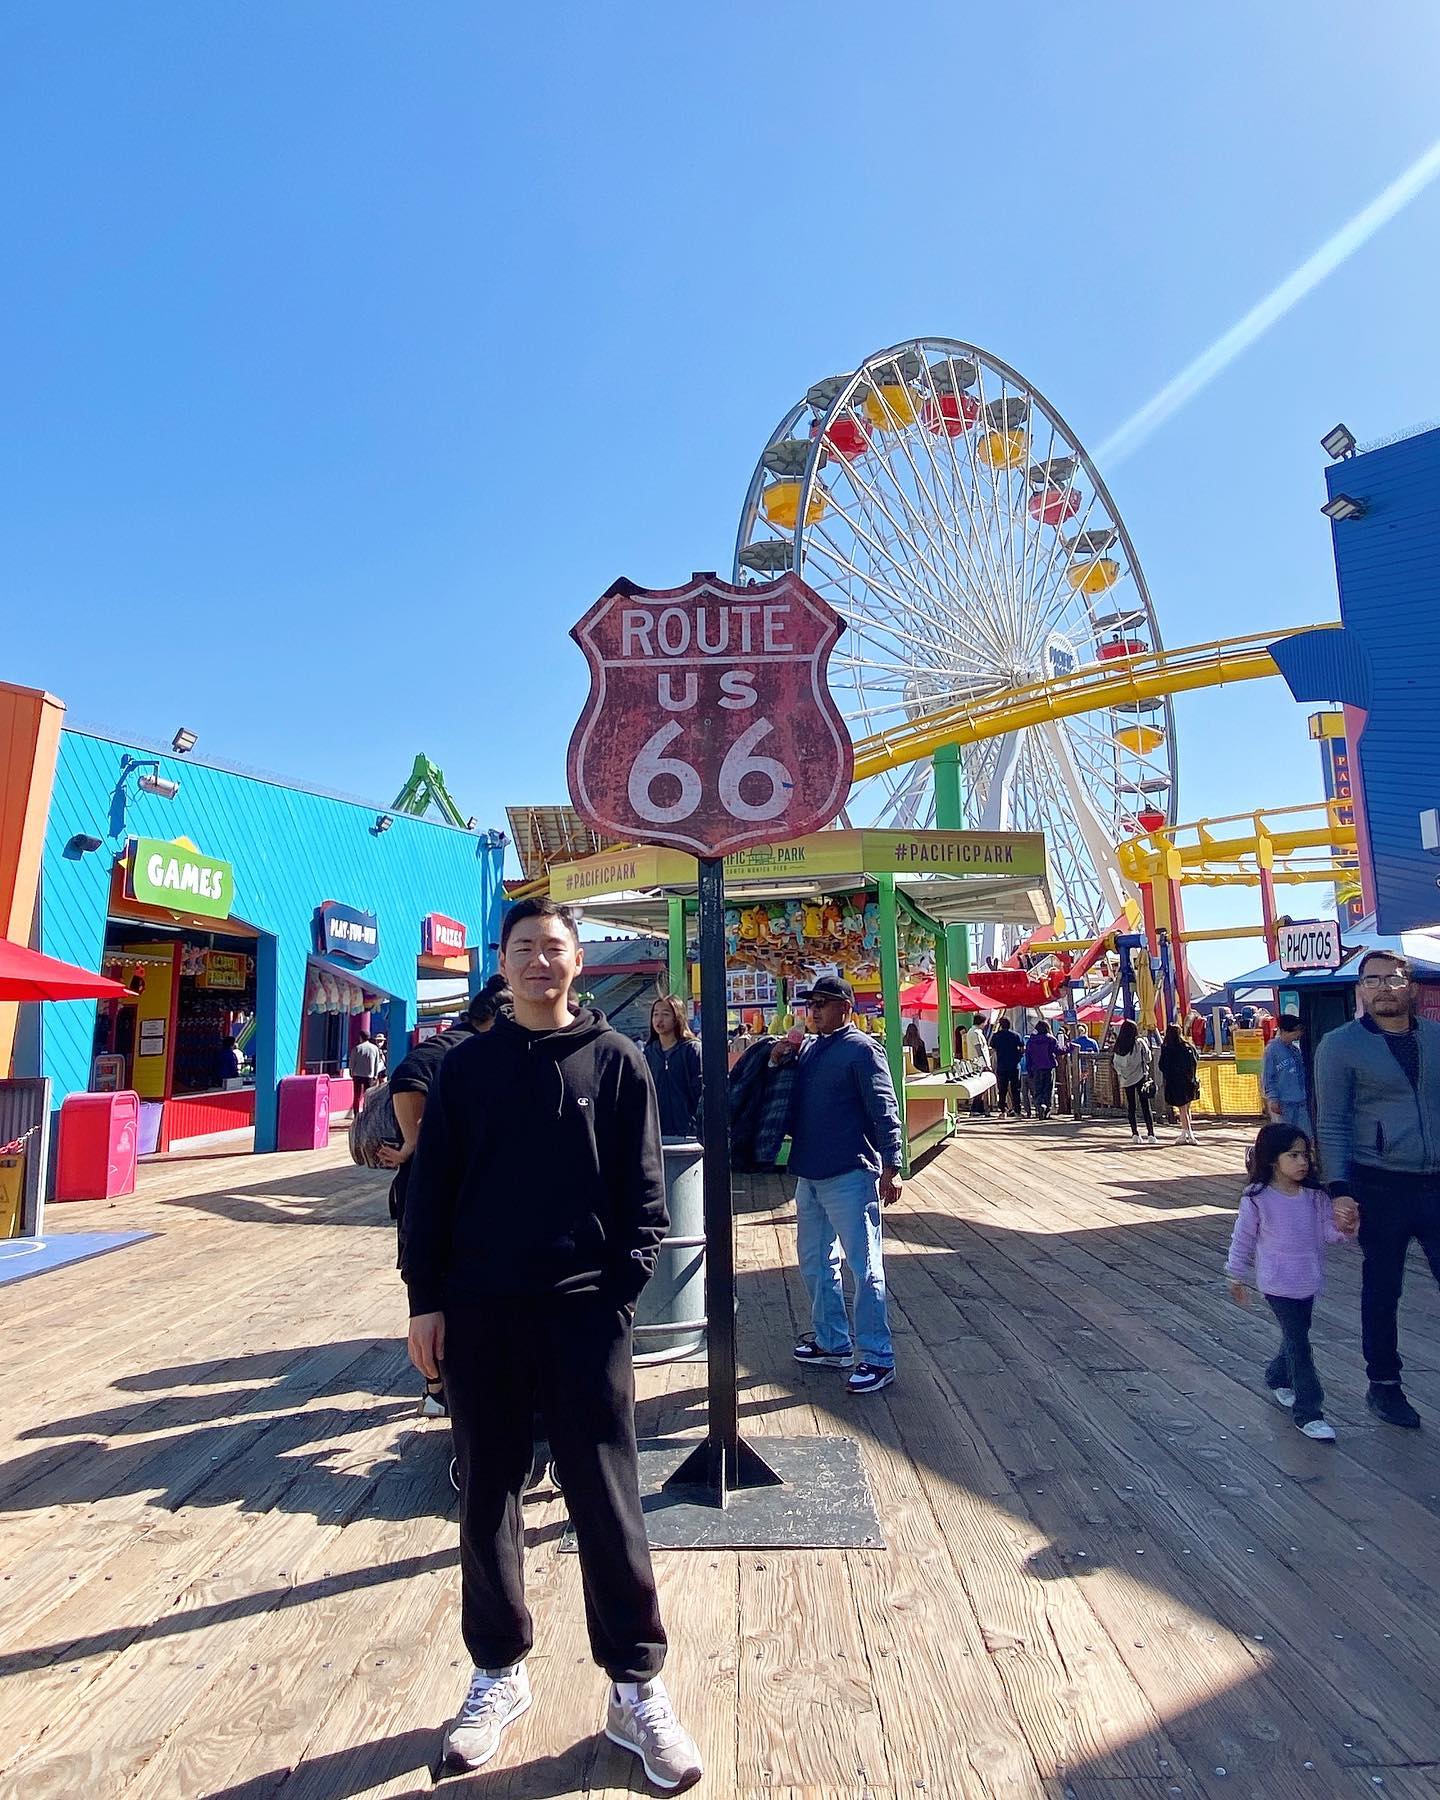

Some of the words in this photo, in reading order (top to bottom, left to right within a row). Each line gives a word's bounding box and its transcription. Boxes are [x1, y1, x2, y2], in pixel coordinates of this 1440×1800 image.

[621, 604, 794, 657] ROUTE
[628, 716, 795, 824] 66
[777, 846, 806, 862] PARK
[895, 843, 1014, 863] #PACIFICPARK
[147, 853, 223, 900] GAMES
[566, 861, 636, 891] #PACIFICPARK
[435, 924, 463, 949] PRIZES
[1287, 931, 1332, 962] PHOTOS
